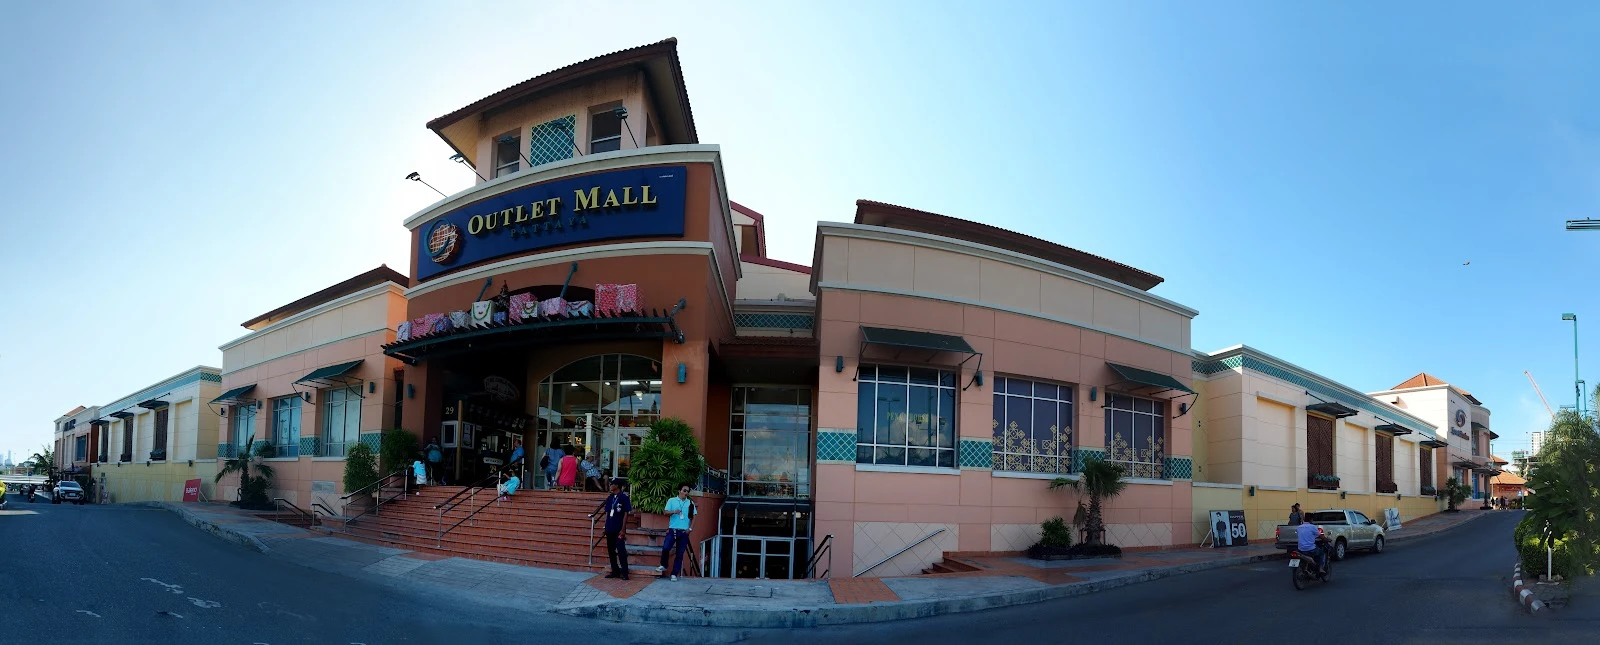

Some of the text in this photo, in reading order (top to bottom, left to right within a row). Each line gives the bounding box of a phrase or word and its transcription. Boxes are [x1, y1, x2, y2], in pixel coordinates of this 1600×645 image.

[467, 185, 657, 235] OUTLET MALL
[510, 216, 588, 237] PATTAYA
[445, 406, 454, 415] 29
[1232, 522, 1246, 538] 50
